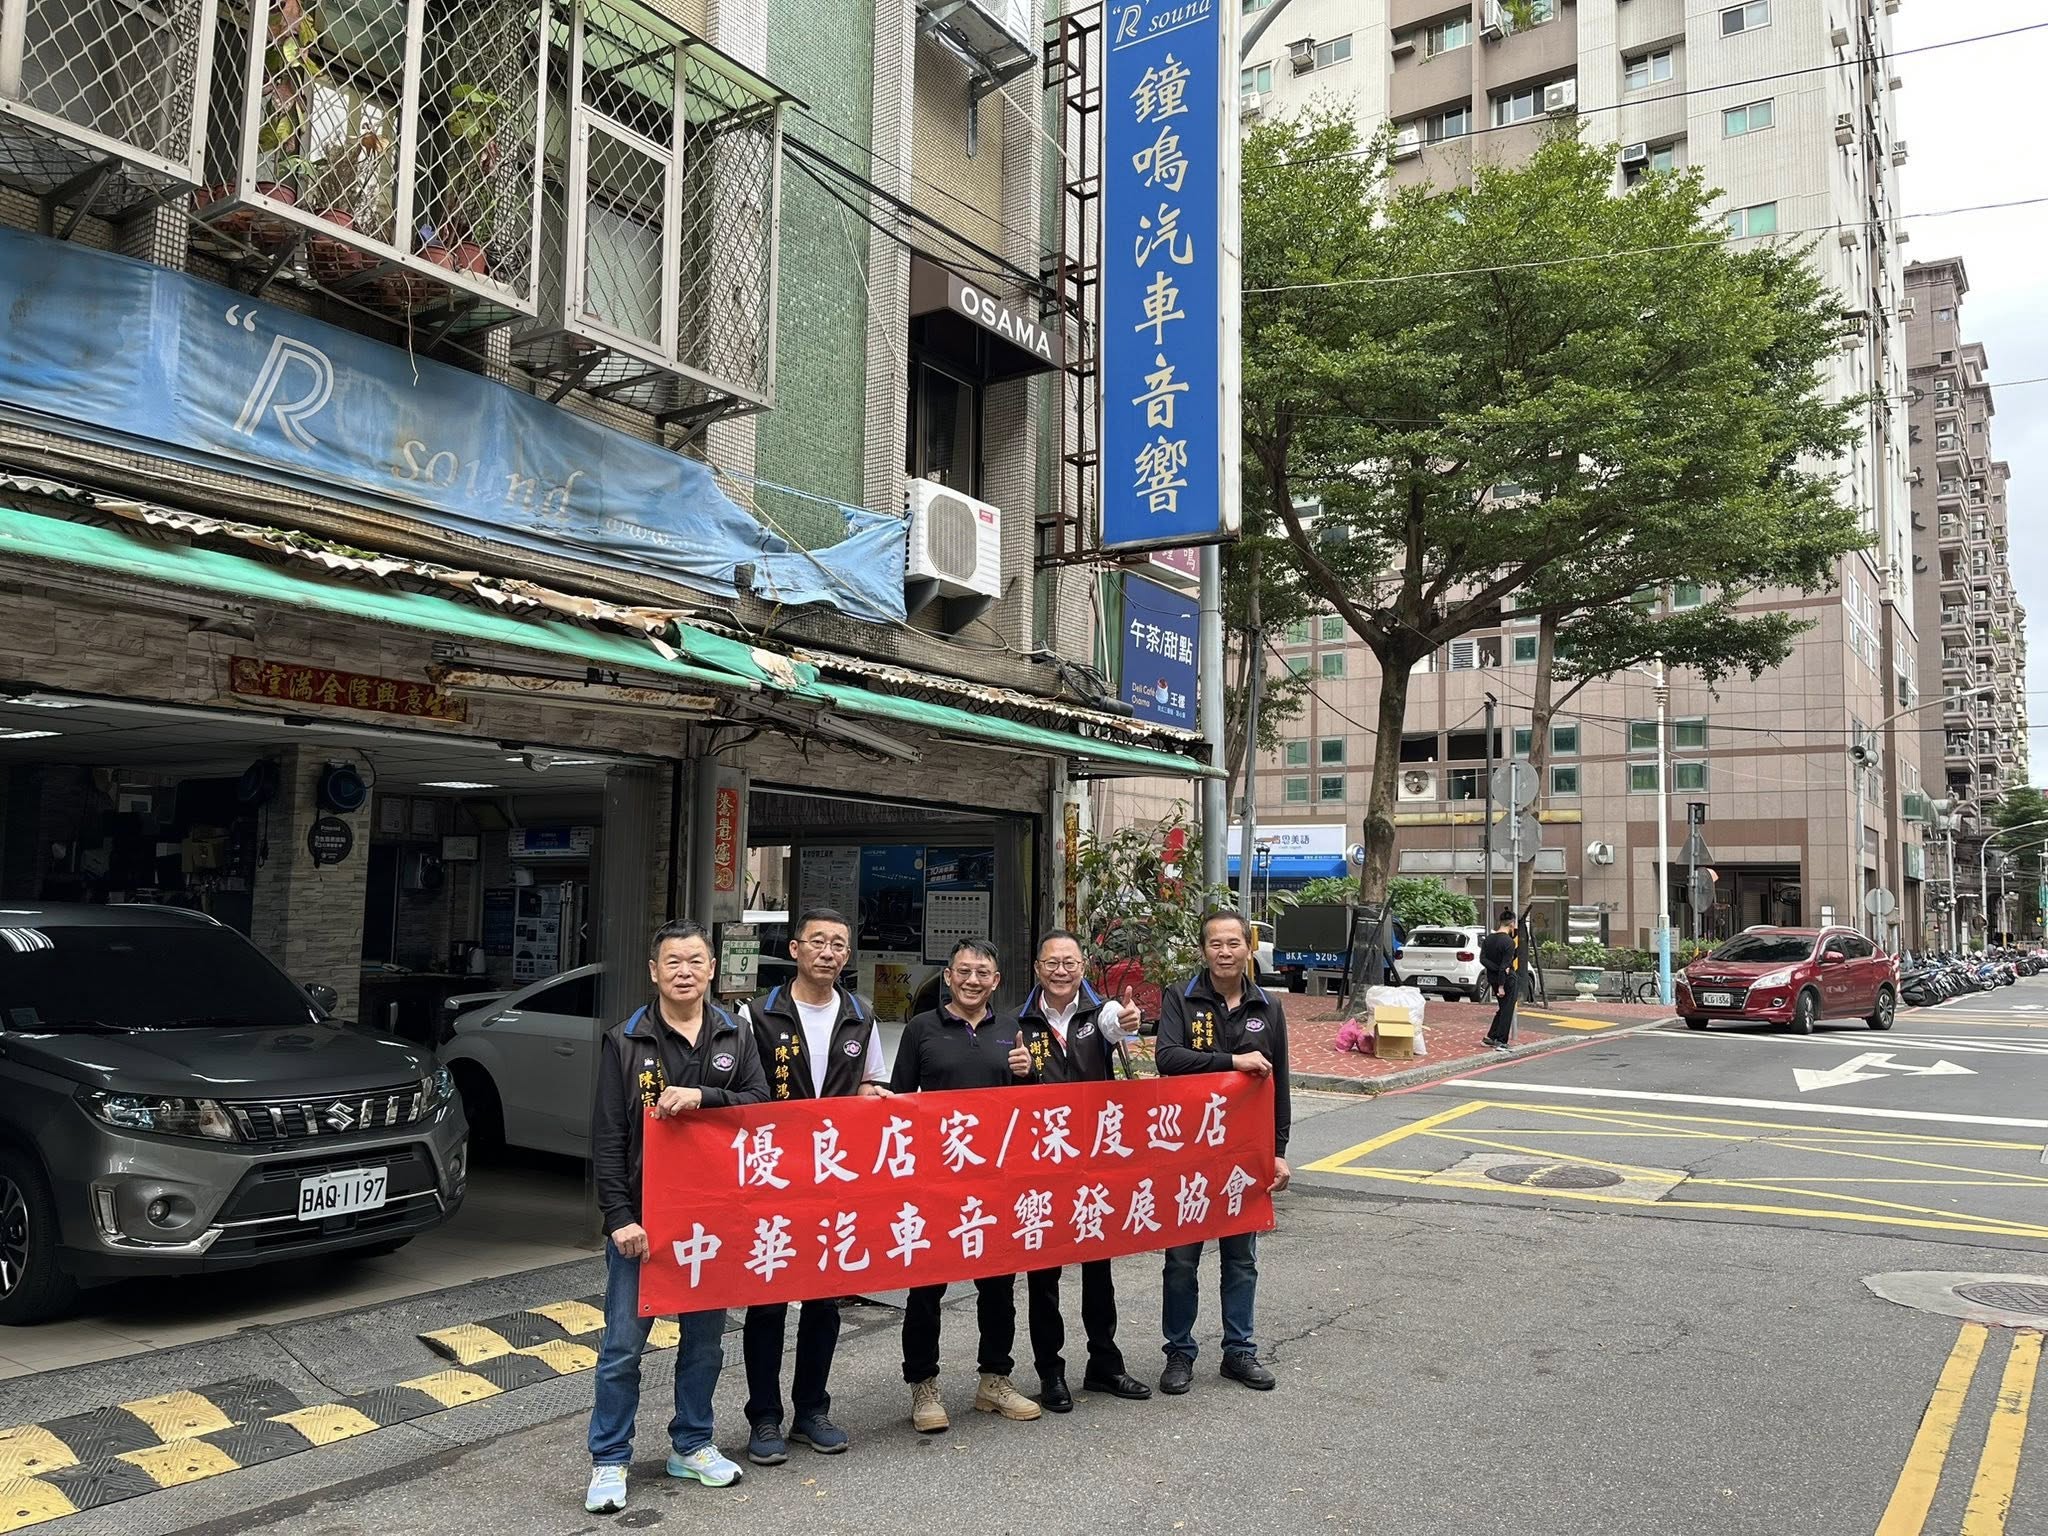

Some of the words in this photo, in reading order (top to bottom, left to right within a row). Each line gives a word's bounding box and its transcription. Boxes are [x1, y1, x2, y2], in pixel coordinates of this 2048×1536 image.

[1129, 52, 1194, 513] 鐘鳴汽車音響
[961, 286, 1051, 360] OSAMA
[1130, 618, 1193, 666] 午茶/甜點
[740, 956, 749, 972] 9
[1315, 952, 1338, 962] 5205
[730, 1092, 1228, 1189] 優良店家/深度巡店
[672, 1164, 1257, 1288] 中華汽車音響發展協會
